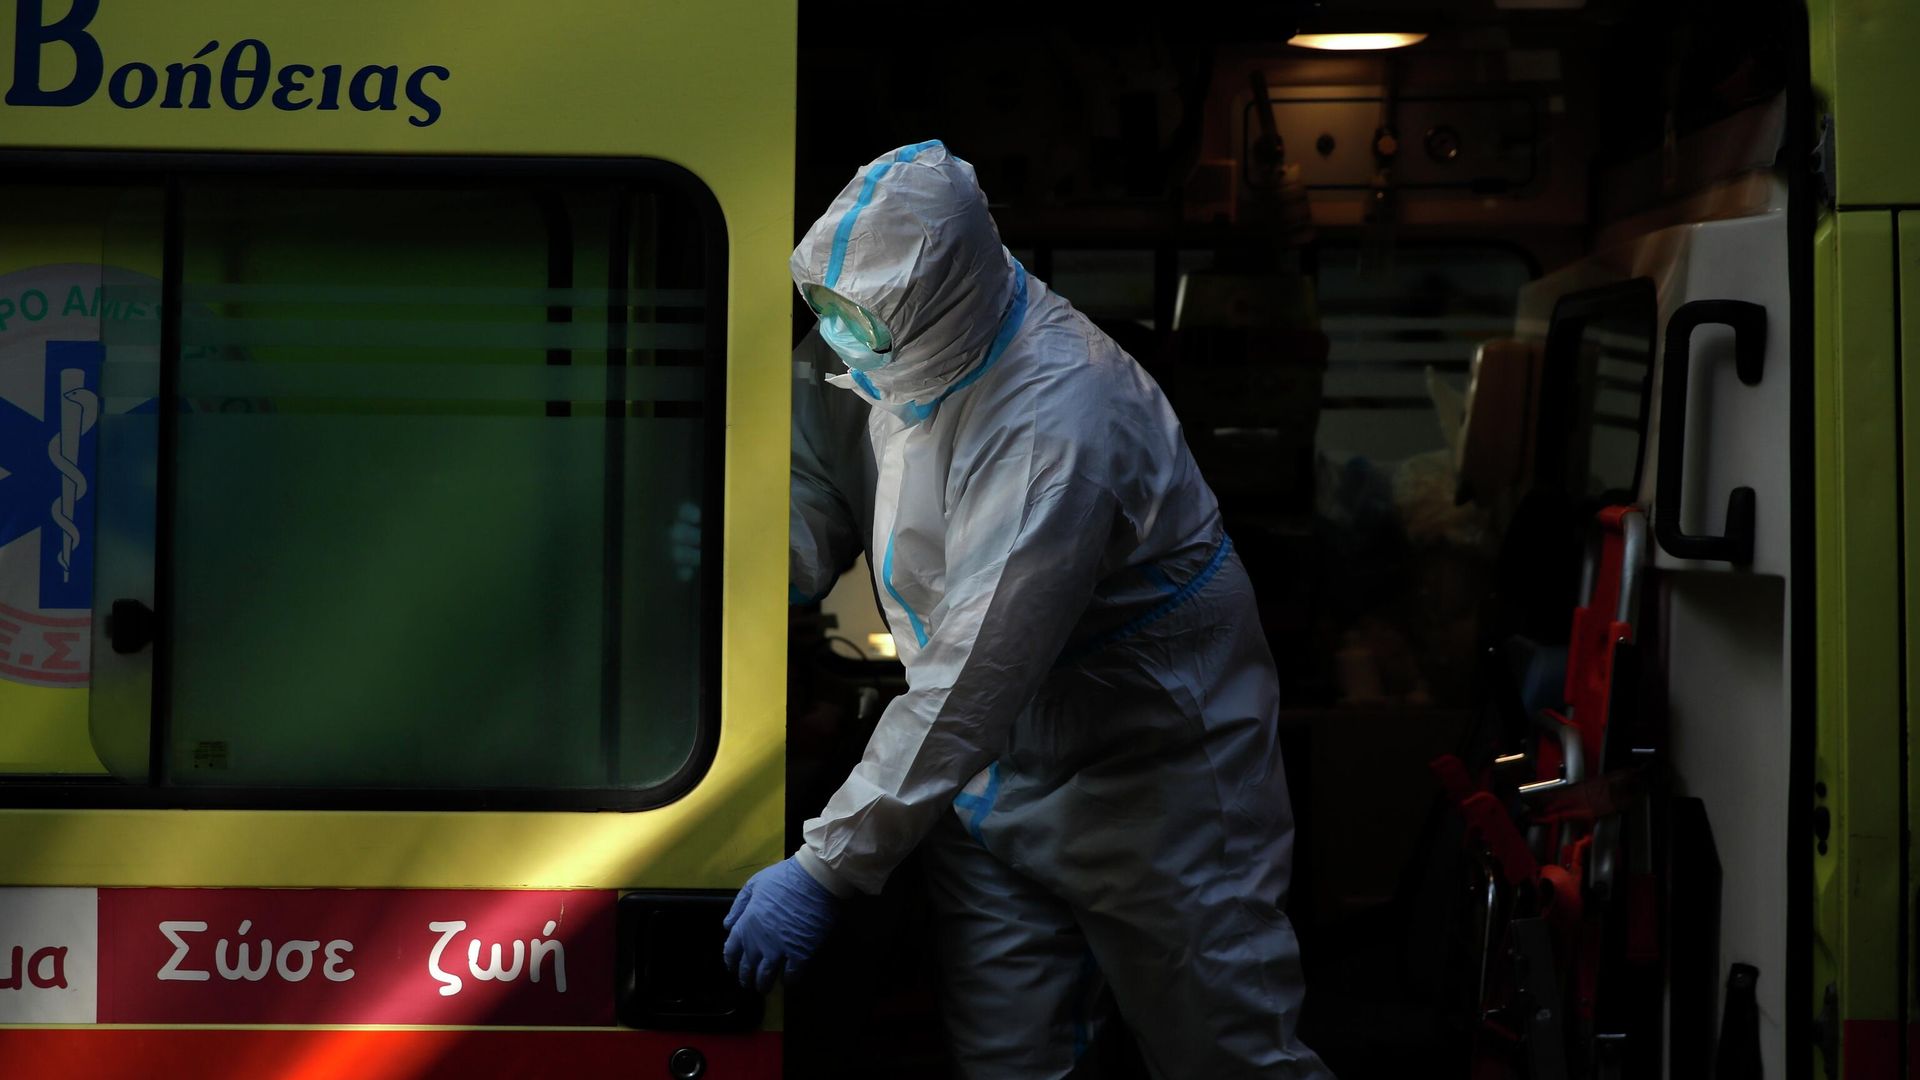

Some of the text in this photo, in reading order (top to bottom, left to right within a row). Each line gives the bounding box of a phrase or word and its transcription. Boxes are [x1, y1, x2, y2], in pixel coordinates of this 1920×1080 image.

[5, 0, 450, 127] Βοήθειας
[156, 919, 356, 982] Σώσε
[427, 919, 568, 996] ζωή
